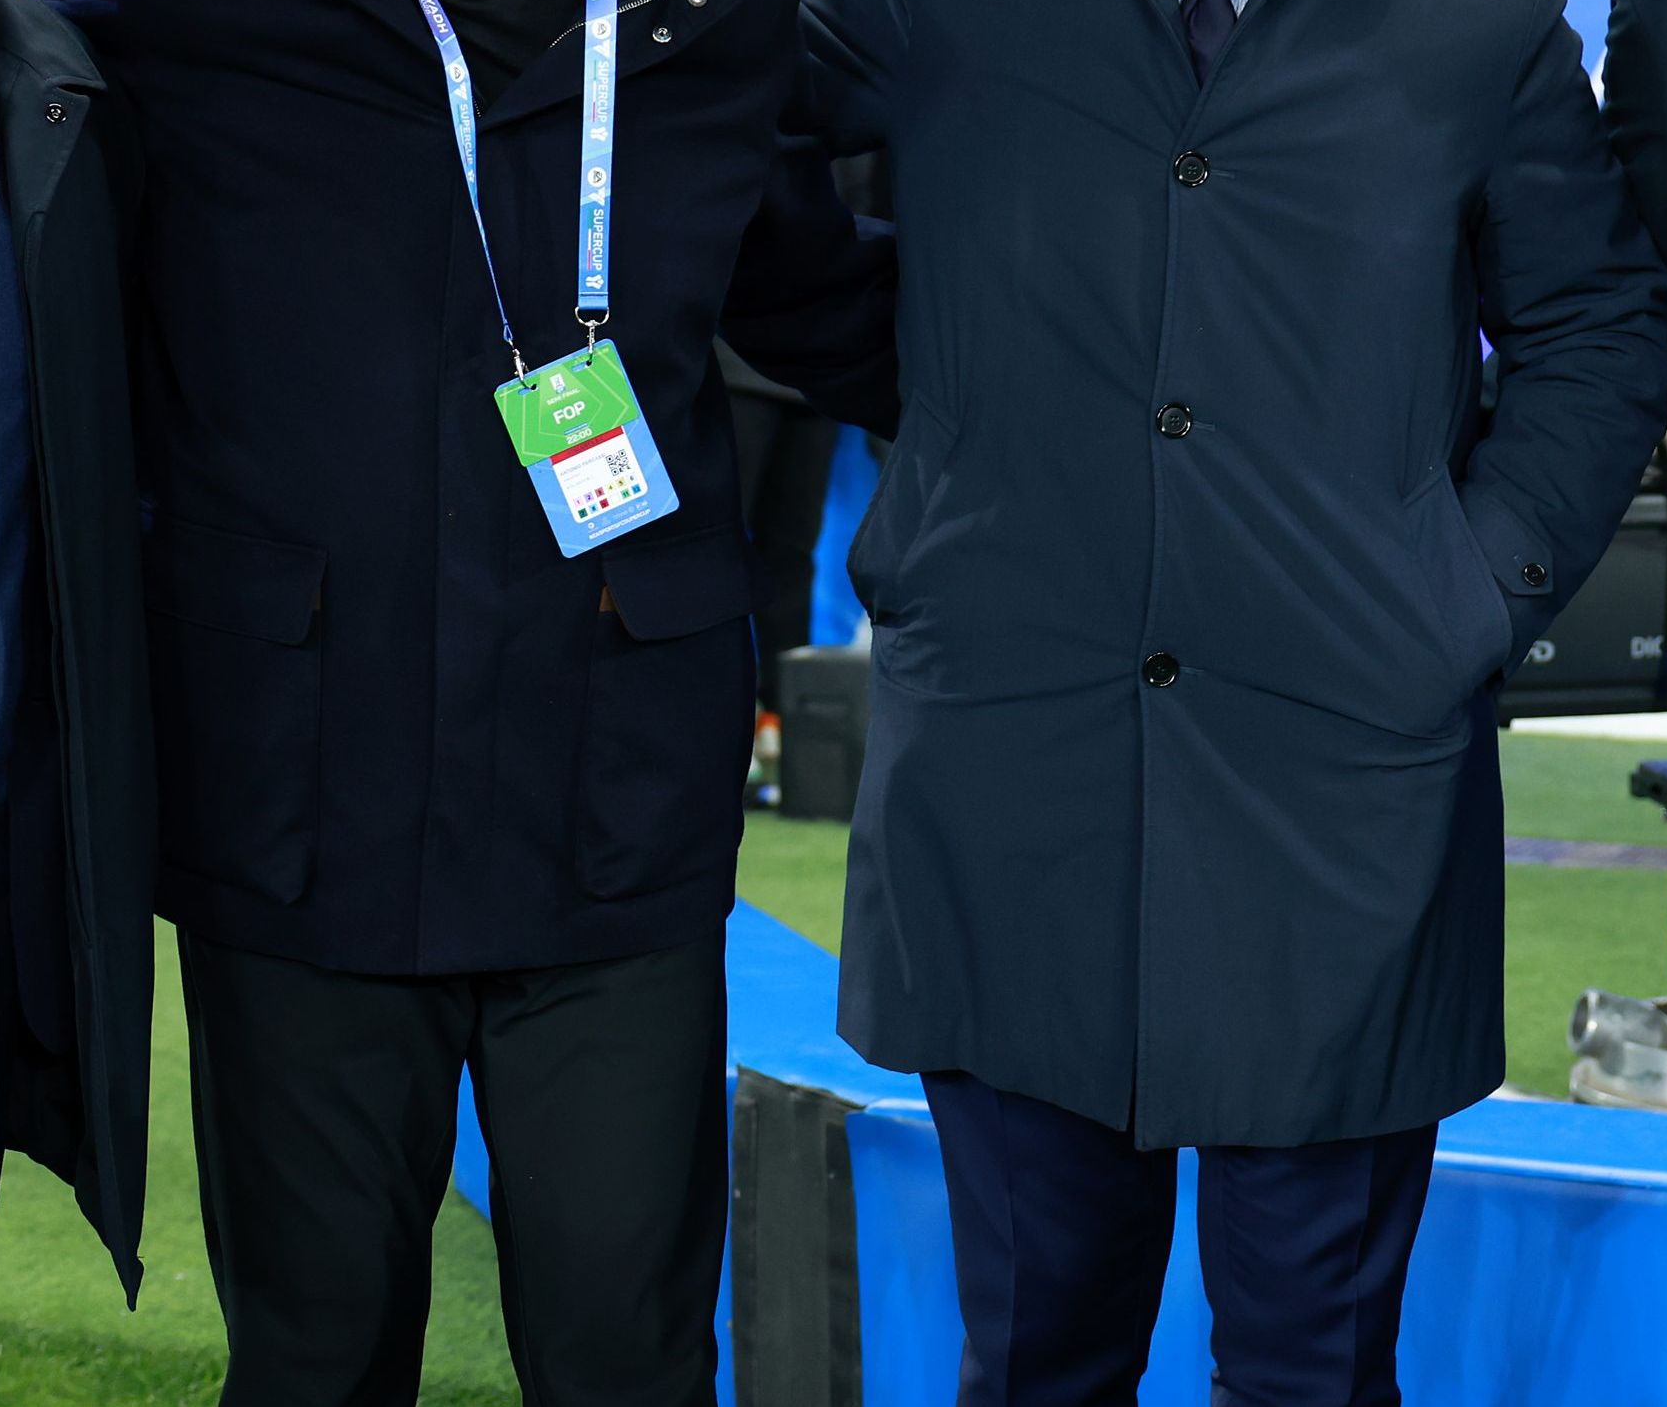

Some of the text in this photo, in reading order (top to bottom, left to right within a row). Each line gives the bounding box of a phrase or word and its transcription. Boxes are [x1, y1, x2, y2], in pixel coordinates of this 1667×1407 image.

[598, 60, 609, 123] SUPERCUP
[460, 103, 473, 165] SUPERCUP
[592, 208, 604, 271] SUPERCUP
[553, 401, 586, 425] FOP
[566, 428, 592, 444] 22:00
